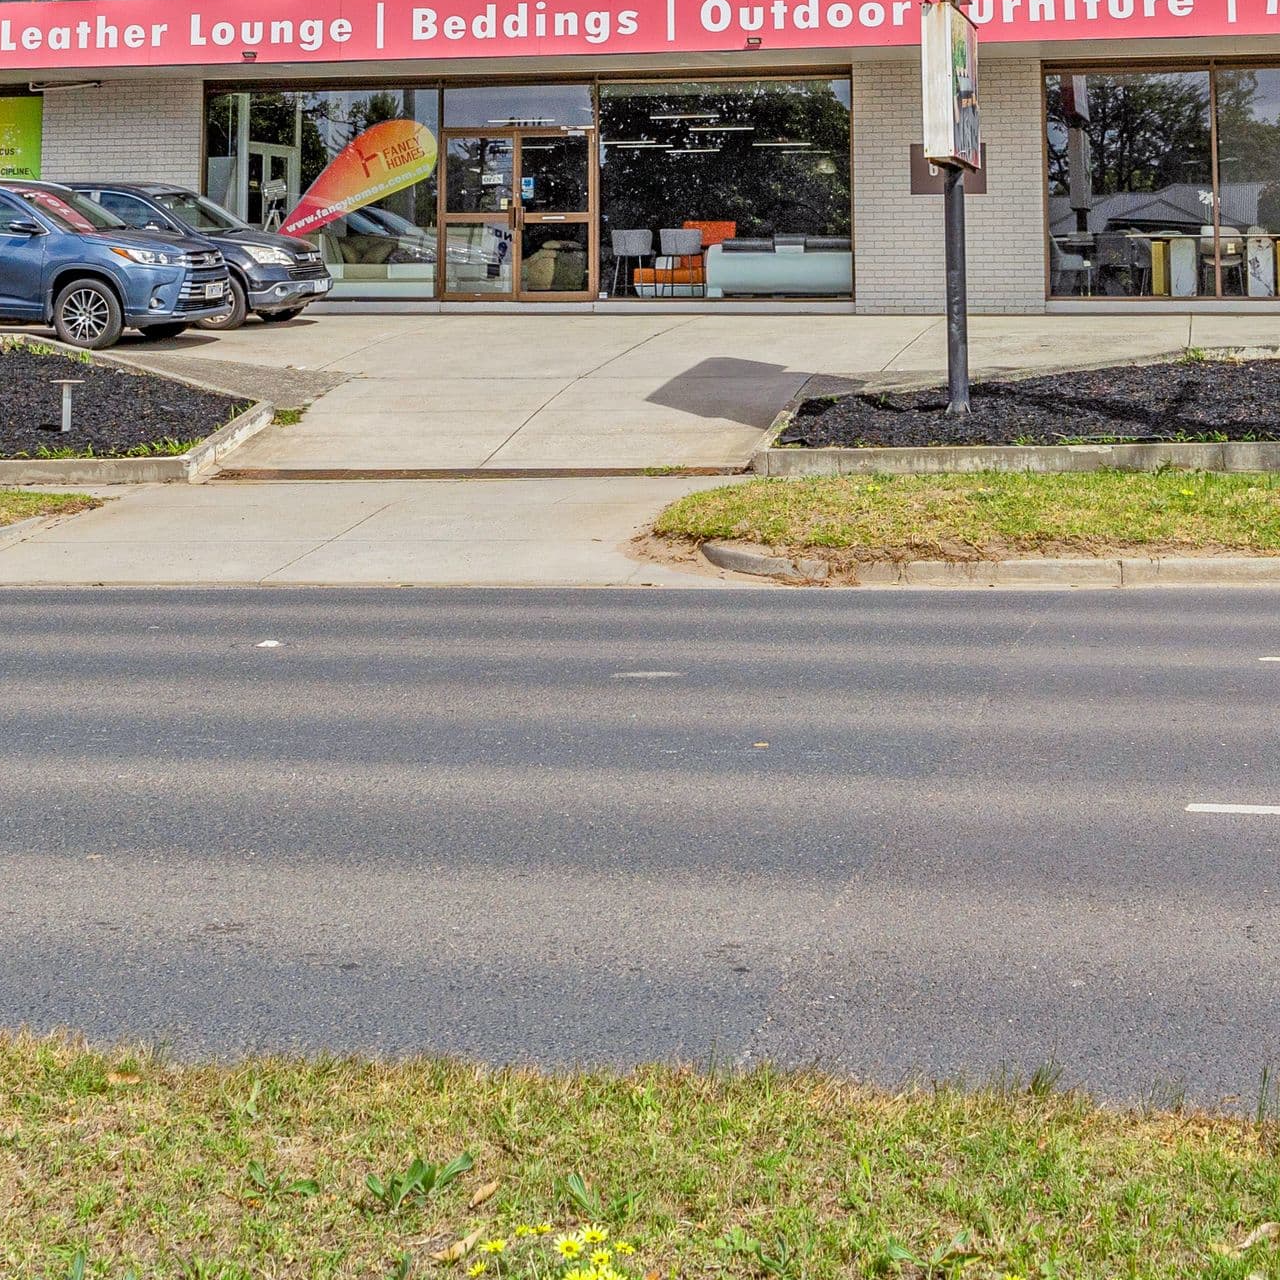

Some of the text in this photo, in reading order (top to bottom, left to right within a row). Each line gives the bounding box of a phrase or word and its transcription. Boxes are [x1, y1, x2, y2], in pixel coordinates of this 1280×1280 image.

[0, 15, 168, 52] Leather
[190, 13, 353, 52] Lounge
[412, 1, 640, 44] Beddings
[382, 135, 421, 160] FANCY
[386, 148, 426, 170] HOMES
